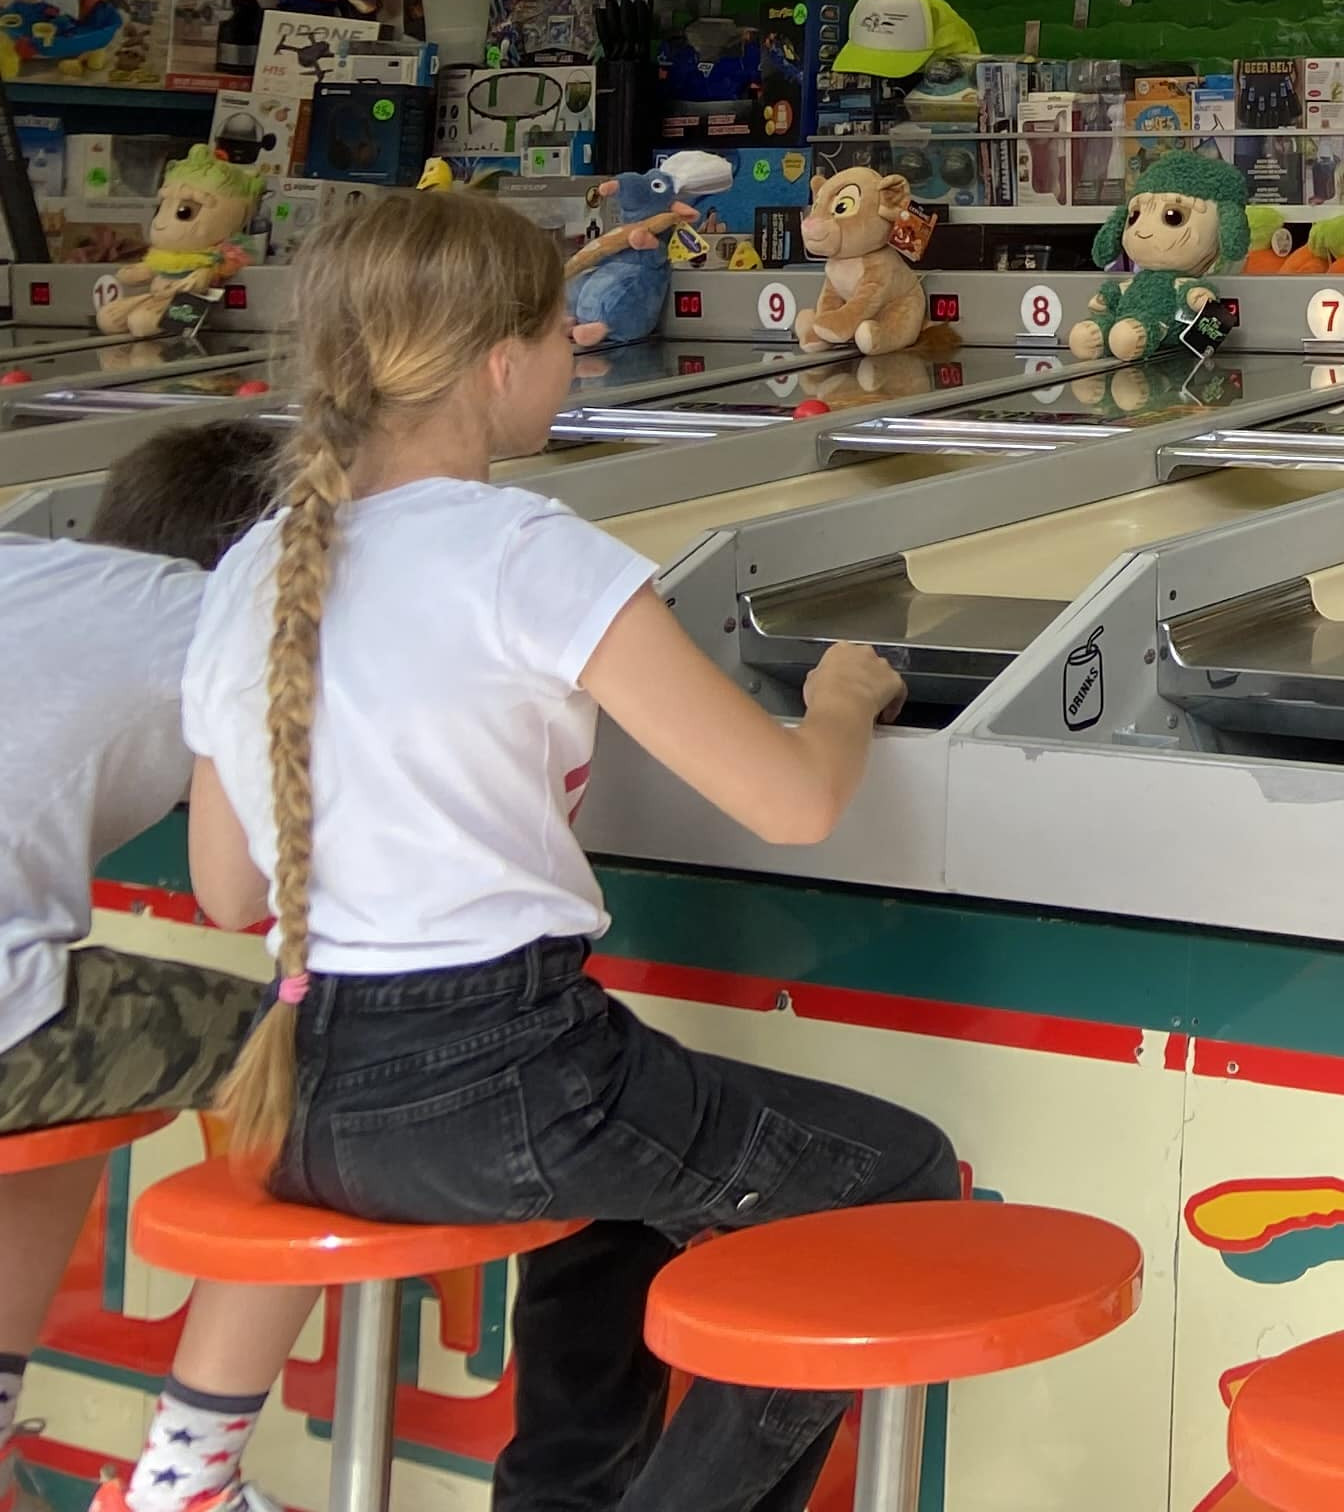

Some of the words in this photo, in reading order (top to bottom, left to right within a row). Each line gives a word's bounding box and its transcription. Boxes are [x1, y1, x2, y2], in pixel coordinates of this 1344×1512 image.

[1245, 61, 1269, 74] BEER
[1270, 61, 1294, 73] BELT
[96, 285, 119, 306] 12
[769, 292, 786, 322] 9
[936, 299, 957, 318] 00
[1033, 295, 1051, 327] 8
[1322, 301, 1340, 332] 7
[1068, 666, 1099, 717] DRINKS
